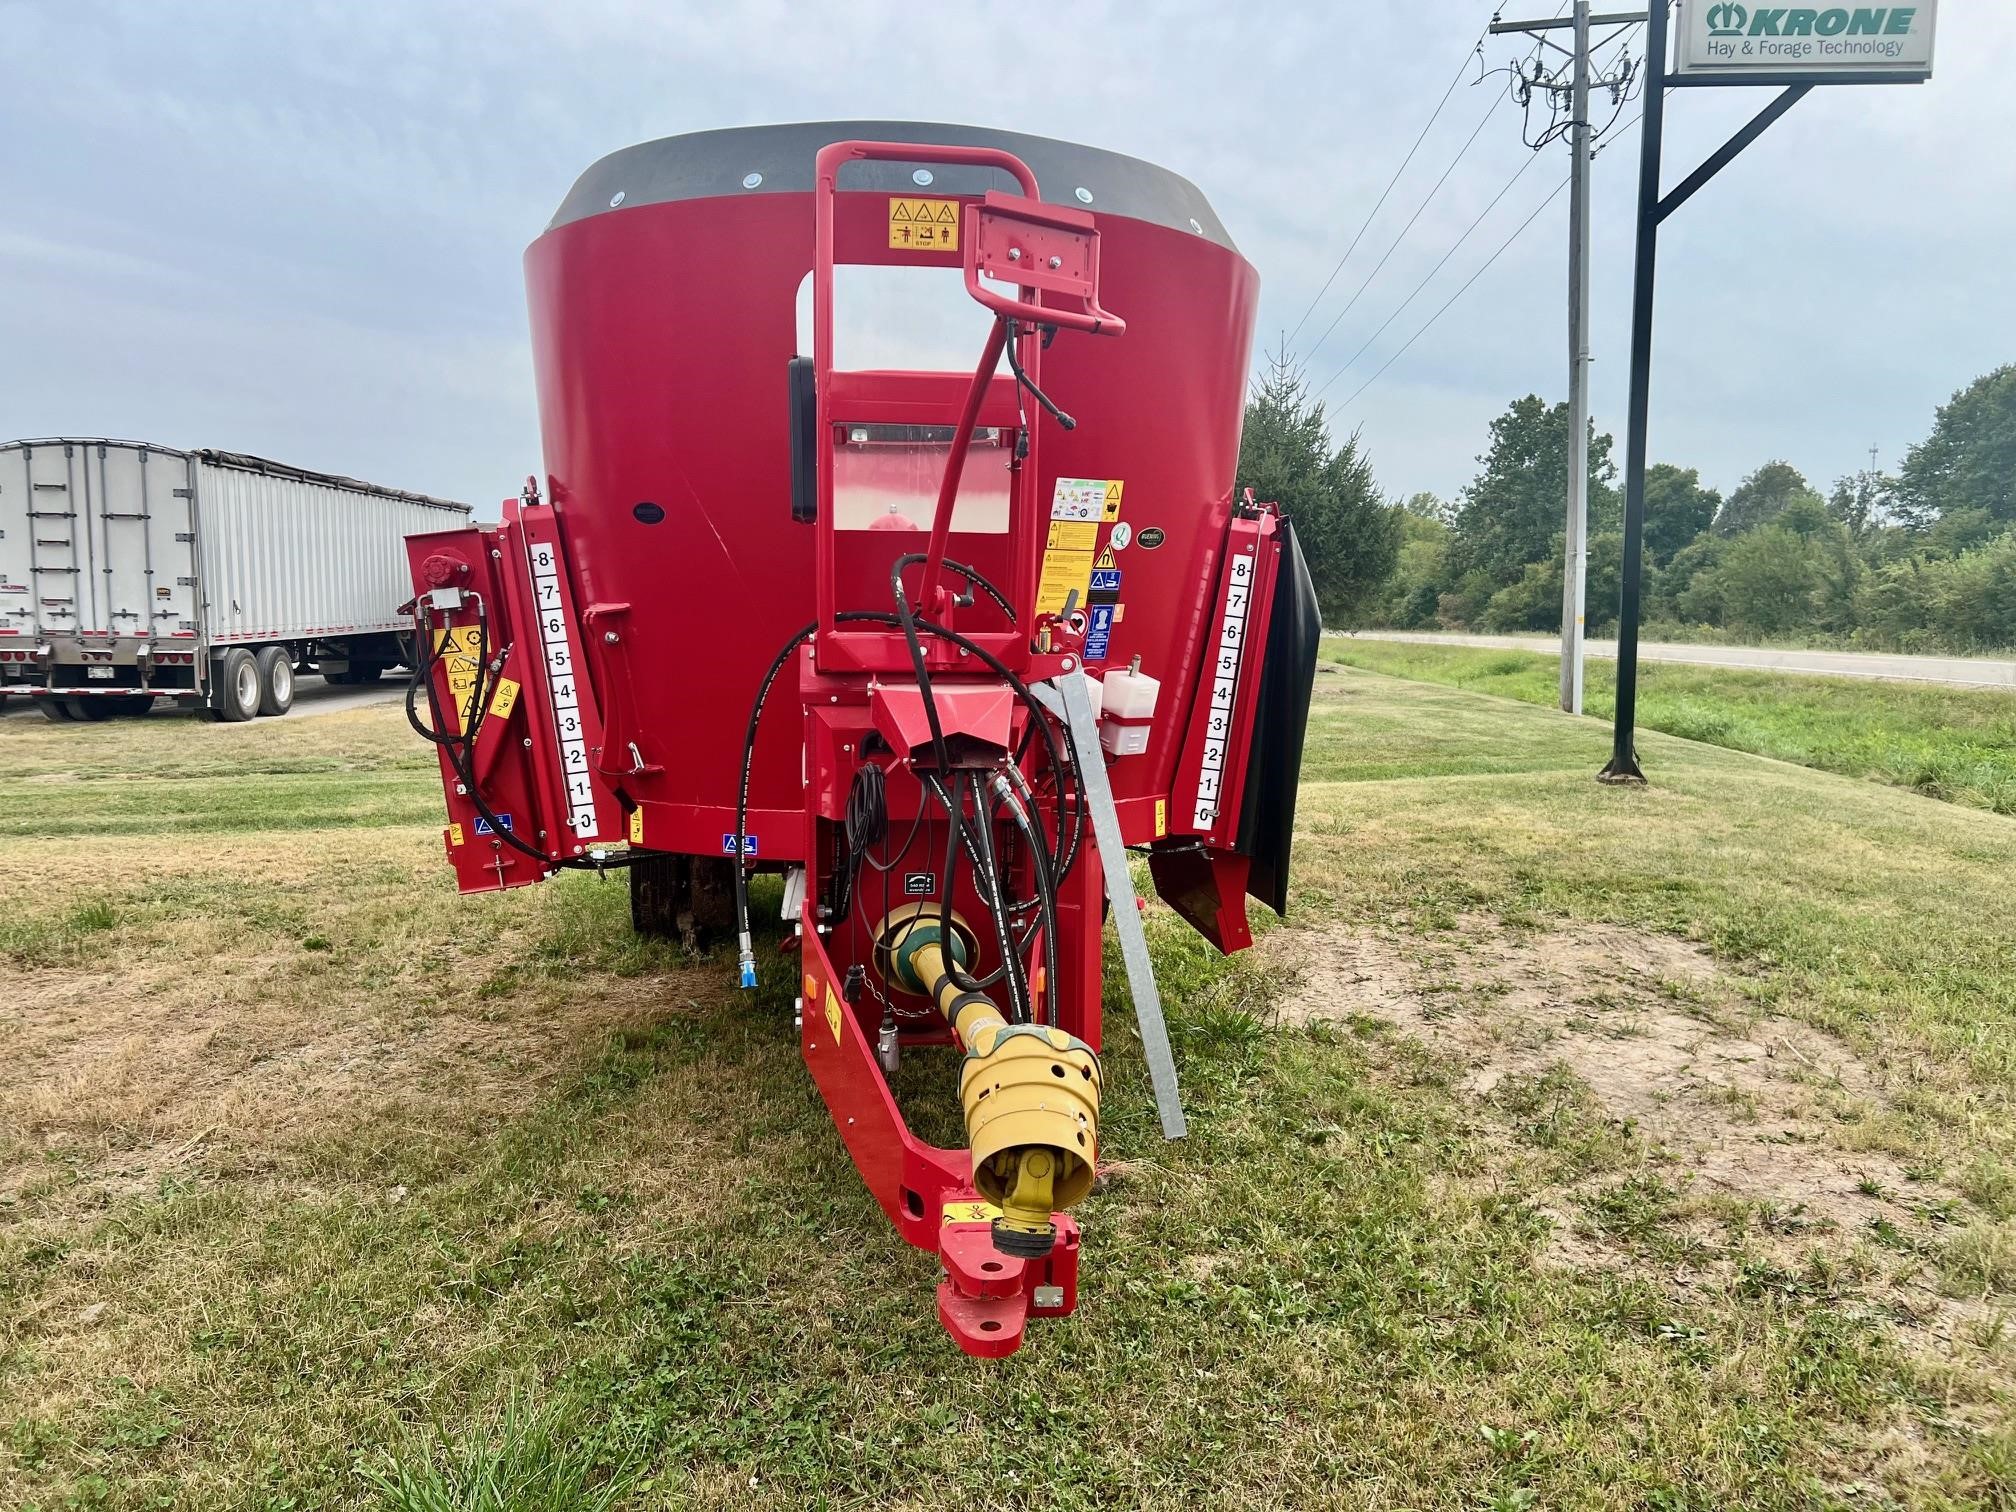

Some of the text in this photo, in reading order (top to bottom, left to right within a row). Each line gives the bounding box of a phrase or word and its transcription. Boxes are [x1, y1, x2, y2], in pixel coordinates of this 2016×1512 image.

[1747, 8, 1916, 36] KRONE
[1707, 40, 1904, 58] Hay & Forage Technology
[538, 552, 549, 566] 8
[1236, 563, 1246, 577] 8
[543, 585, 553, 599] 7
[1233, 594, 1242, 608] 7
[549, 619, 559, 633] 6
[1227, 625, 1236, 639] 6
[555, 652, 565, 666] 5
[1222, 656, 1232, 670] 5
[560, 684, 570, 698] 4
[1217, 687, 1227, 700] 4
[565, 717, 575, 731] 3
[1213, 717, 1222, 731] 3
[570, 750, 581, 764] 2
[1209, 748, 1218, 761] 2
[576, 782, 584, 796] 1
[1205, 778, 1212, 791] 1
